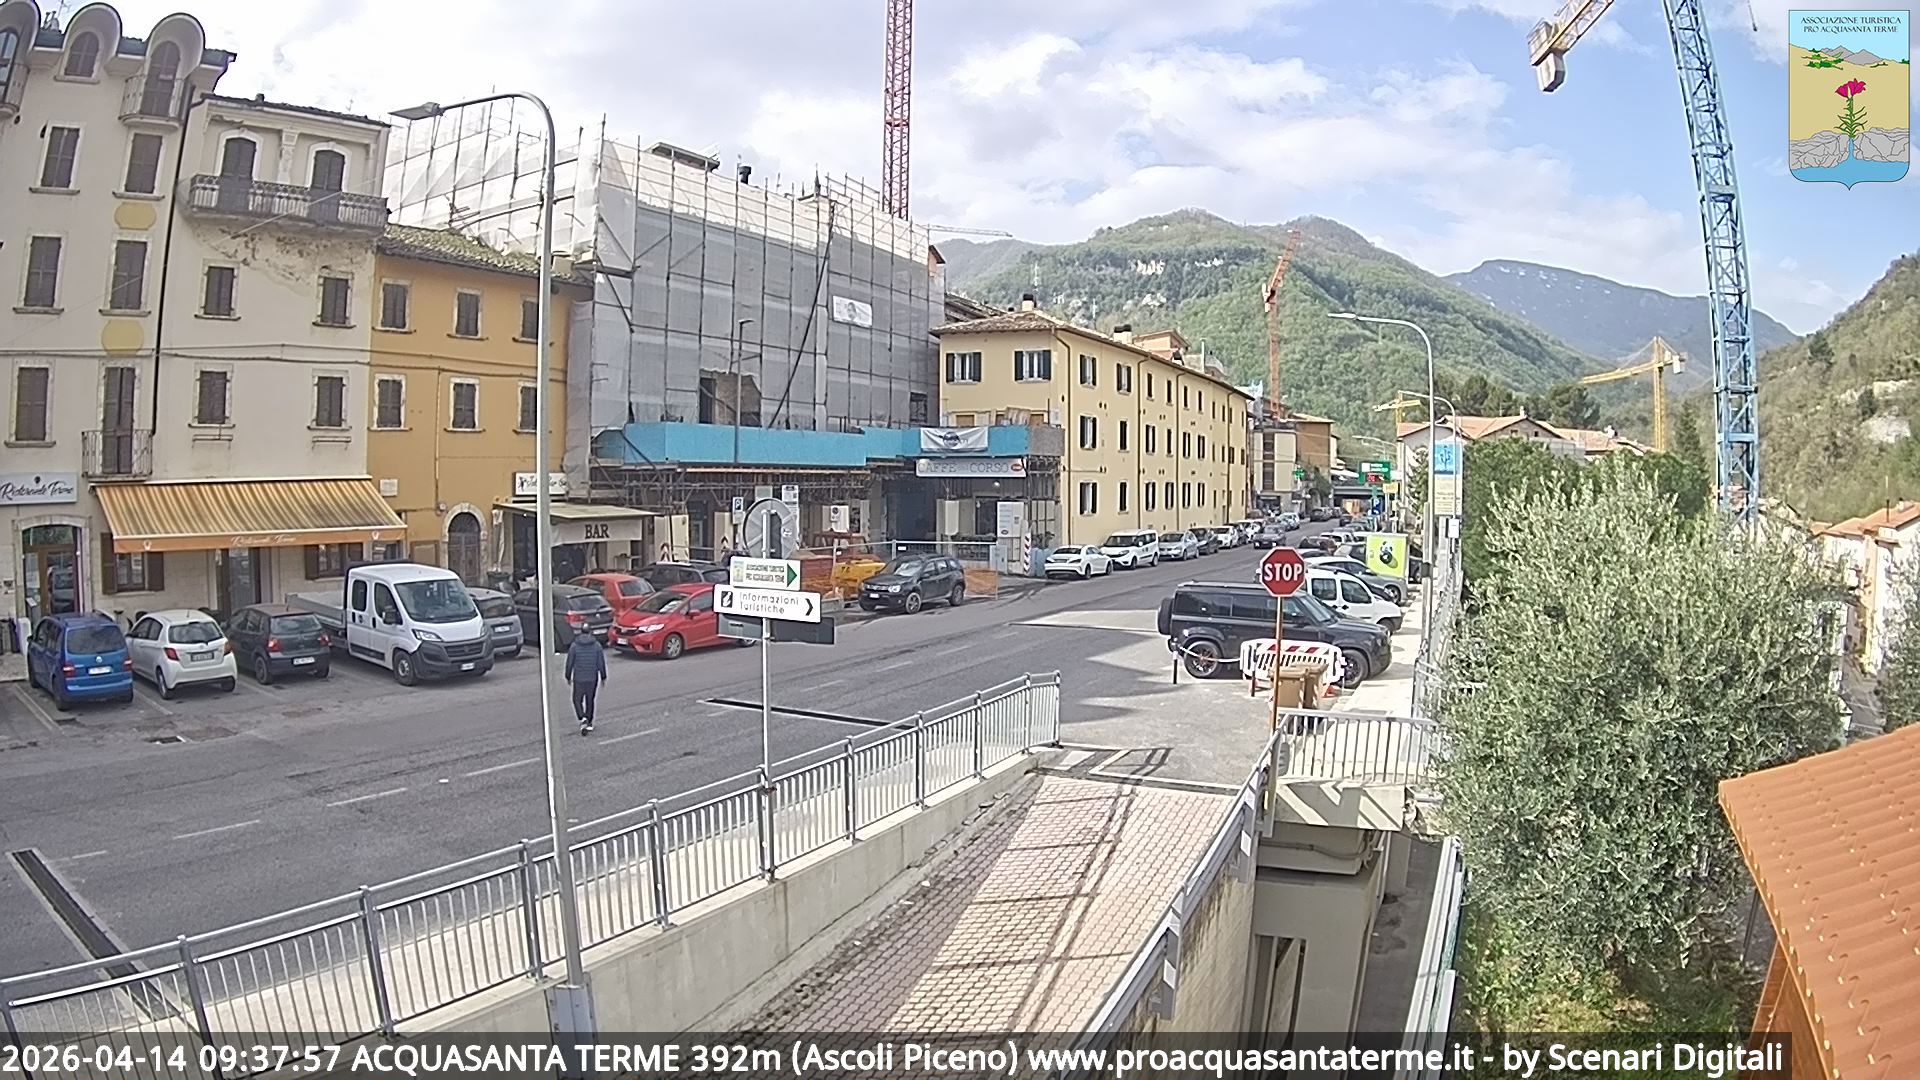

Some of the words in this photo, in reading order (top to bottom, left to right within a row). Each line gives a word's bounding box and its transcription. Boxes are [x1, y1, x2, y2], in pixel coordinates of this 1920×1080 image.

[970, 463, 1009, 473] CORSO
[585, 524, 610, 539] BAR
[1264, 563, 1303, 582] STOP
[740, 592, 799, 605] Informazioni
[740, 603, 785, 614] Turistiche
